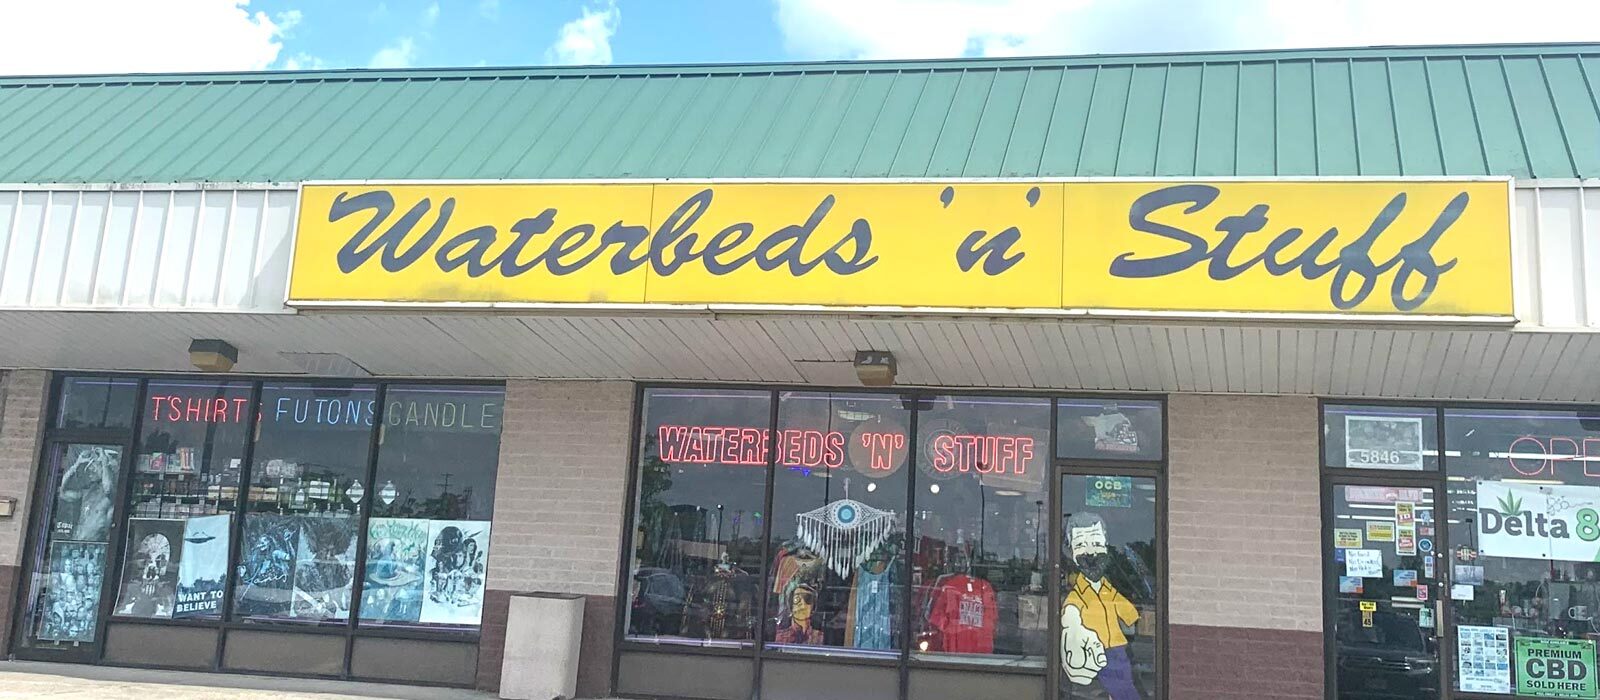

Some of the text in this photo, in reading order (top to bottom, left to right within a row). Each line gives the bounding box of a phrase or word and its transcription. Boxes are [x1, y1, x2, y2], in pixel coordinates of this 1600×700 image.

[328, 184, 1470, 311] Waterbeds 'n' Stuff
[388, 401, 505, 428] CANDLE
[659, 425, 1034, 473] WATERBEDS 'N' STUFF
[1360, 449, 1400, 464] 5846
[1094, 480, 1123, 490] OCB
[1478, 506, 1600, 541] Delta 8
[178, 590, 224, 602] WANT TO
[176, 600, 217, 613] BELIEVE
[1527, 648, 1582, 660] PREMIUM
[1525, 658, 1588, 681] CBD
[1526, 680, 1587, 691] SOLD HERE
